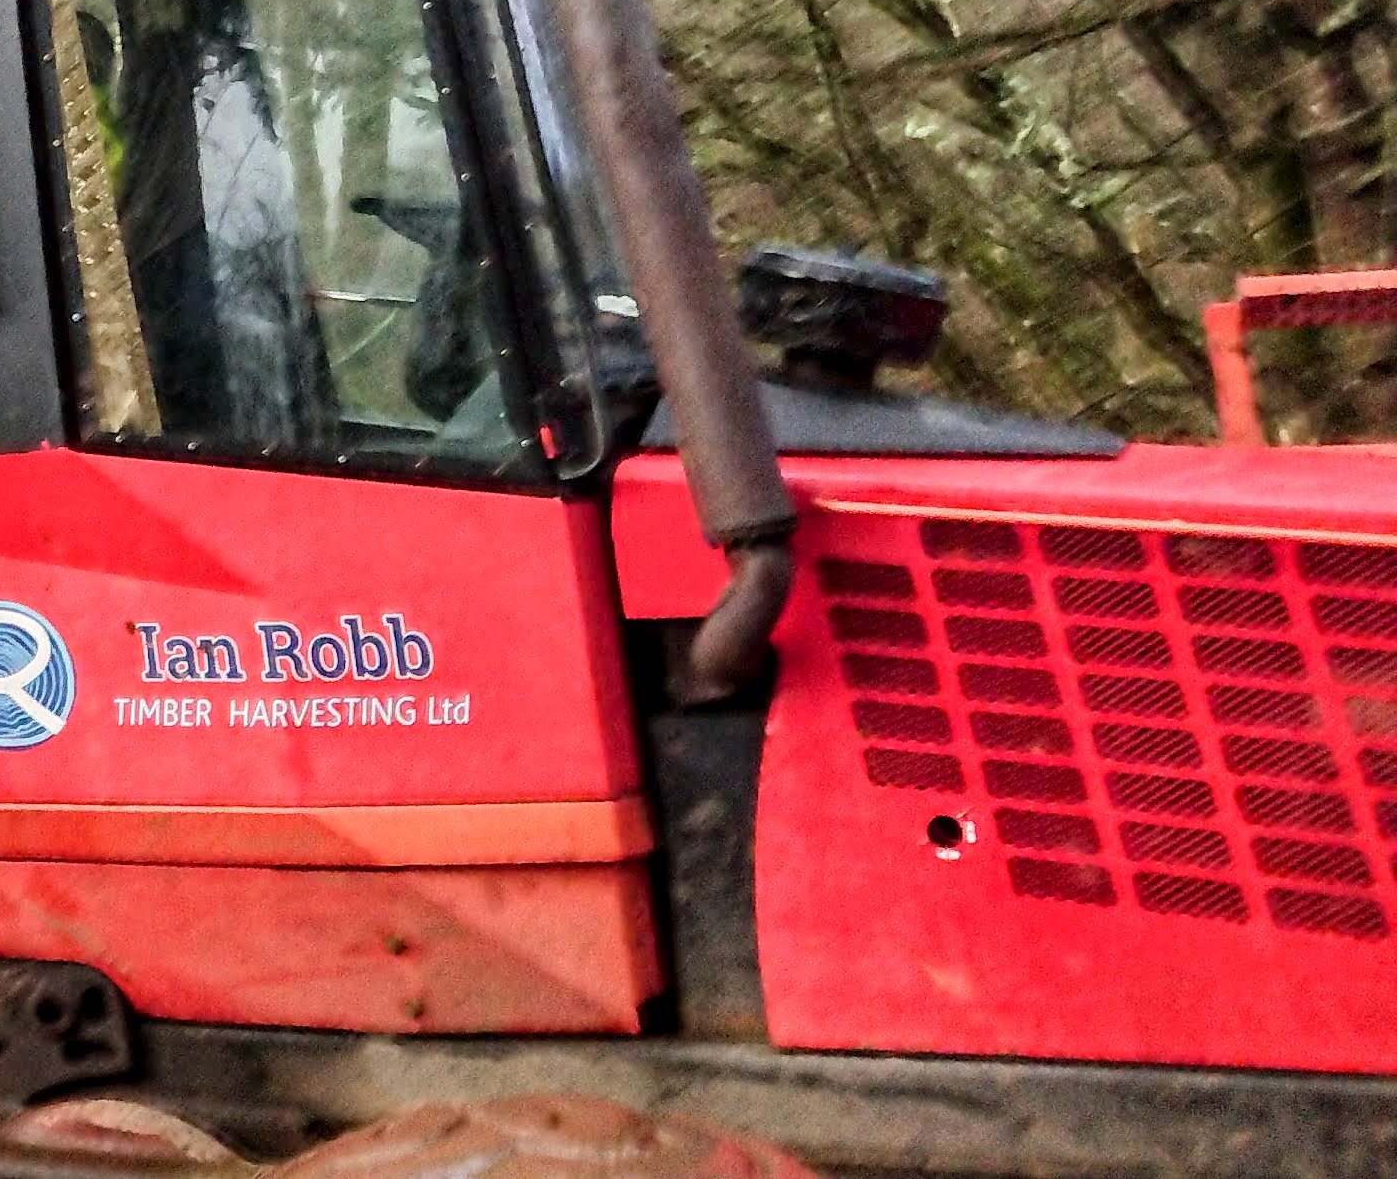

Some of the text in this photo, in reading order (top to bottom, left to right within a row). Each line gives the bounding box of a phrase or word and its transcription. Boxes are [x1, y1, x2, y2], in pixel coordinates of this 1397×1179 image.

[135, 613, 434, 683] Ian Robb
[114, 693, 471, 728] TIMBER HARVESTING Ltd
